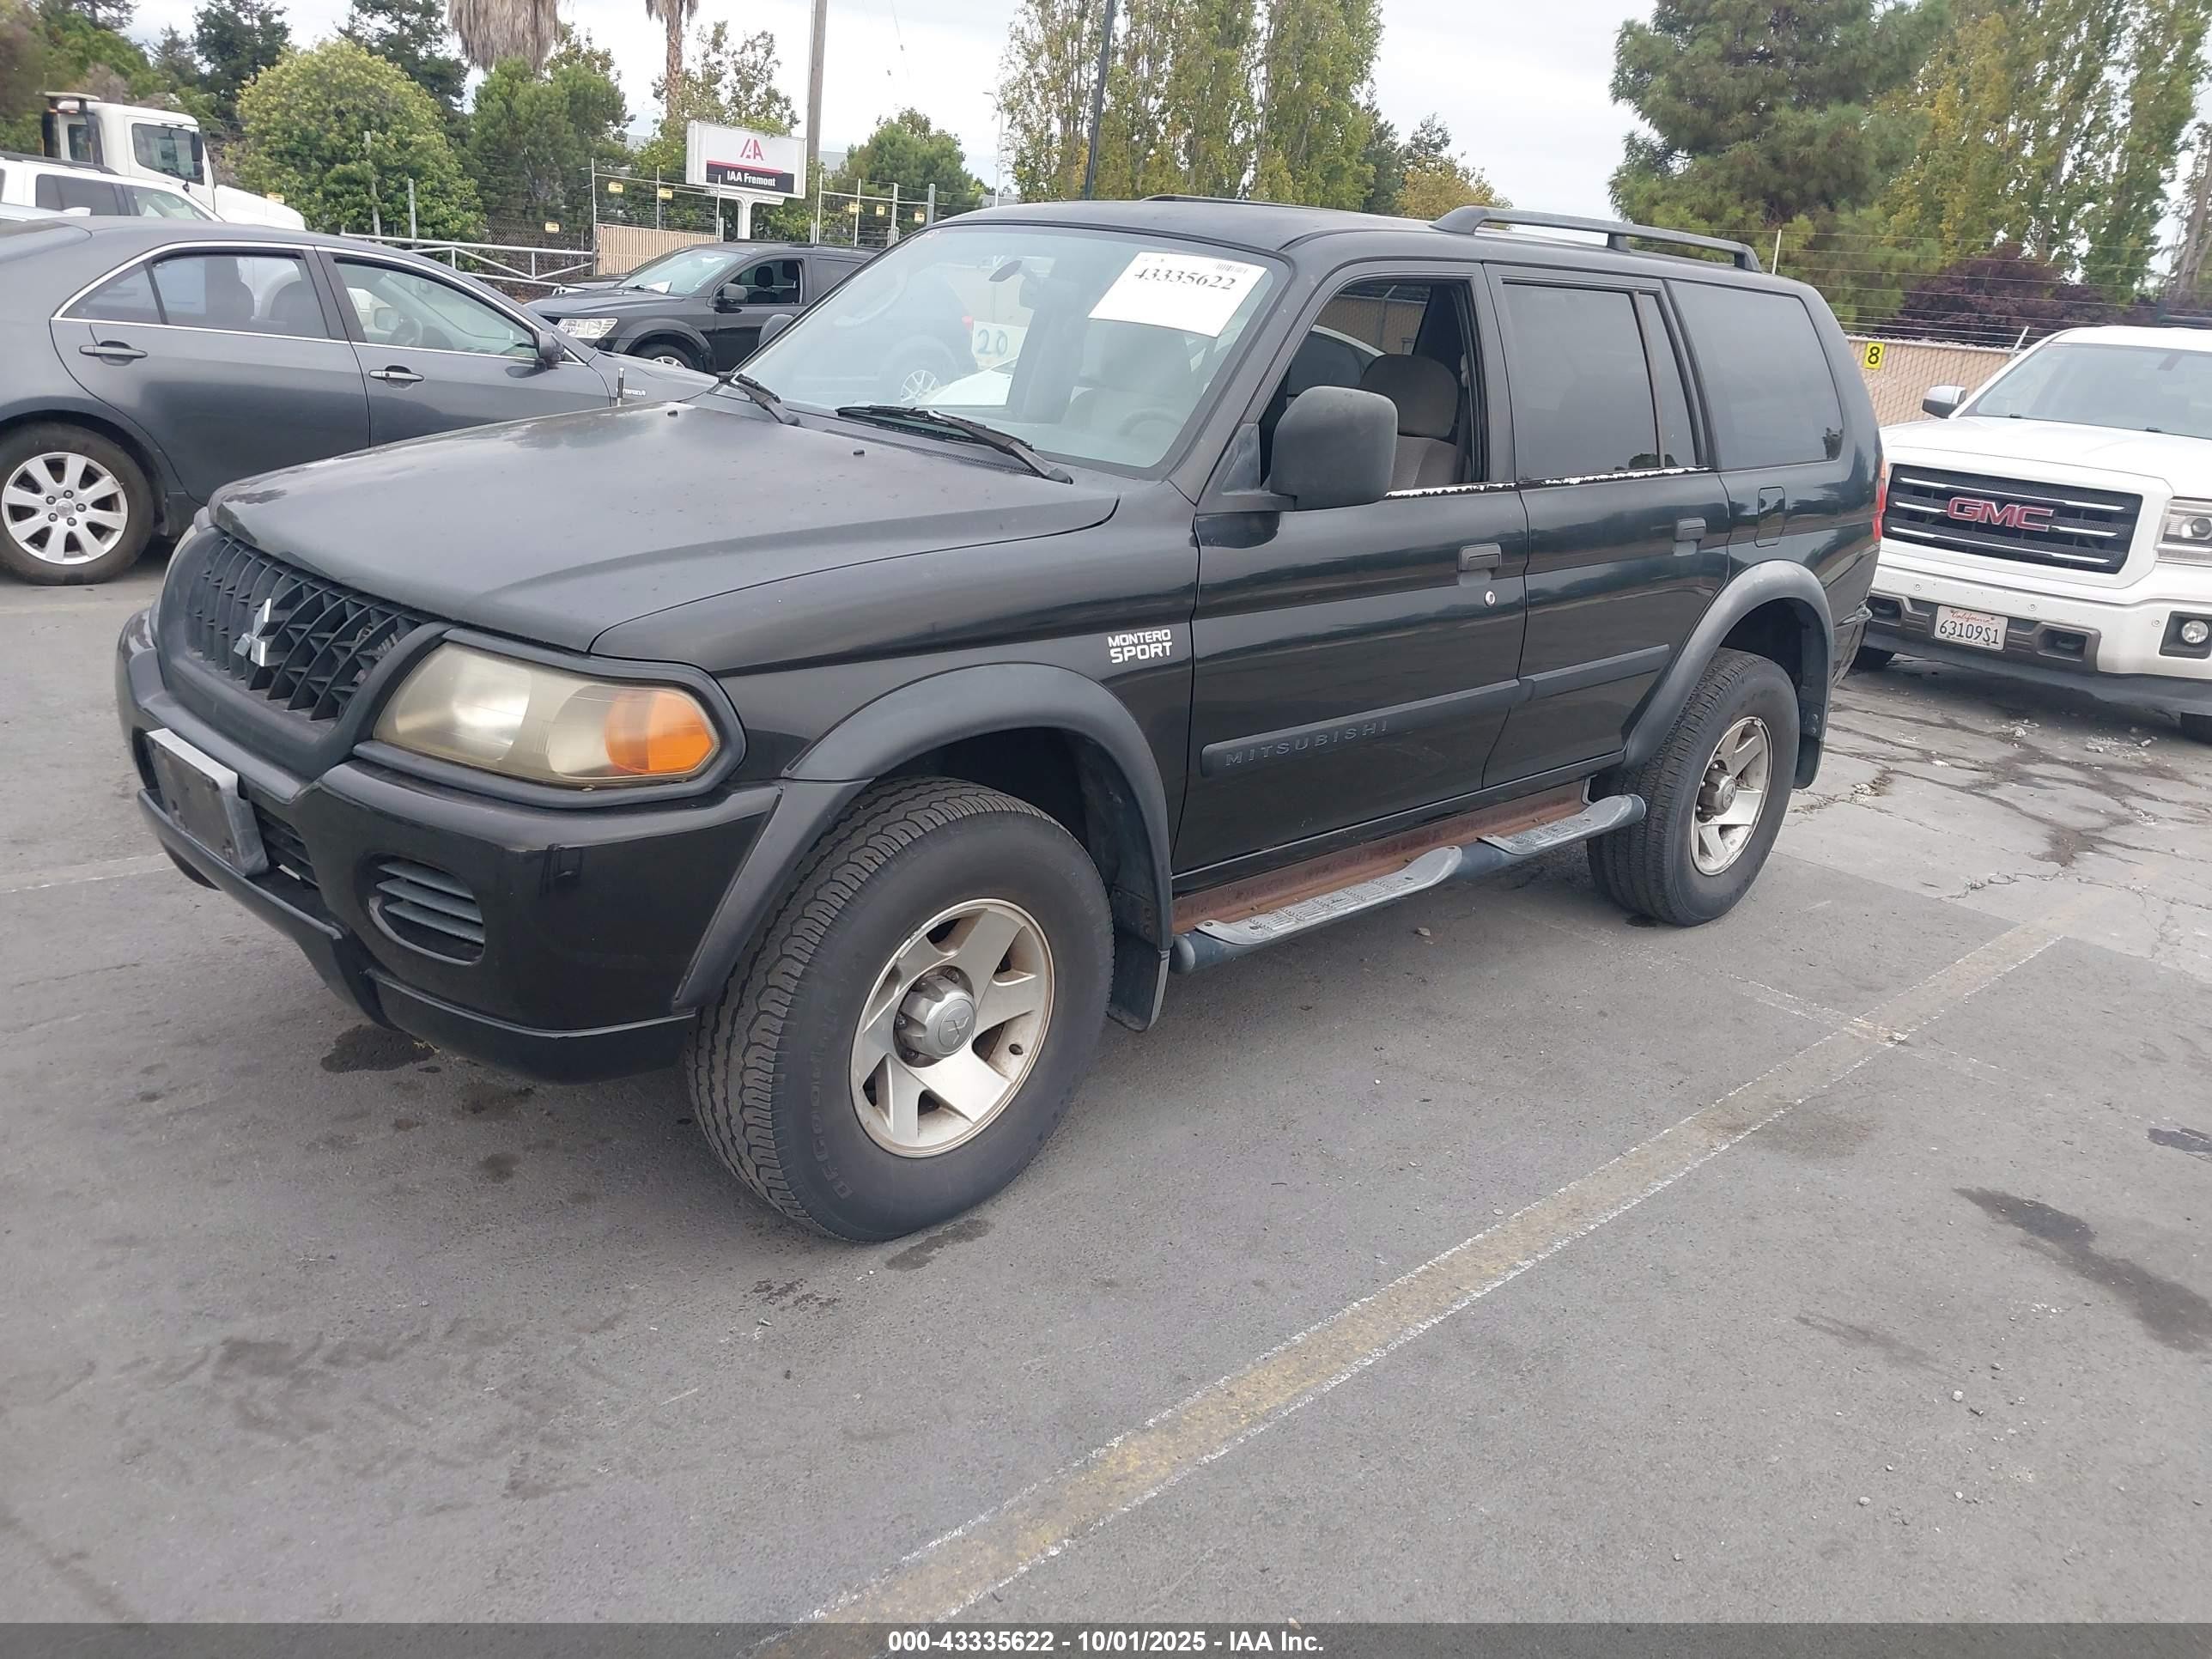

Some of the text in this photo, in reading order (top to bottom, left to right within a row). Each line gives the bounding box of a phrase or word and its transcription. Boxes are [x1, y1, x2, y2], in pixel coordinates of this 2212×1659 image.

[726, 170, 776, 187] IAA Fremont
[1134, 267, 1237, 290] 43335622
[977, 329, 1008, 357] 20
[1868, 346, 1881, 364] 8
[1948, 496, 2055, 532] GMC
[1950, 611, 1990, 623] California
[1108, 629, 1171, 647] MONTERO
[1939, 619, 2000, 645] 63109S1
[1109, 641, 1172, 664] SPORT
[1224, 720, 1389, 766] MITSUBISHI
